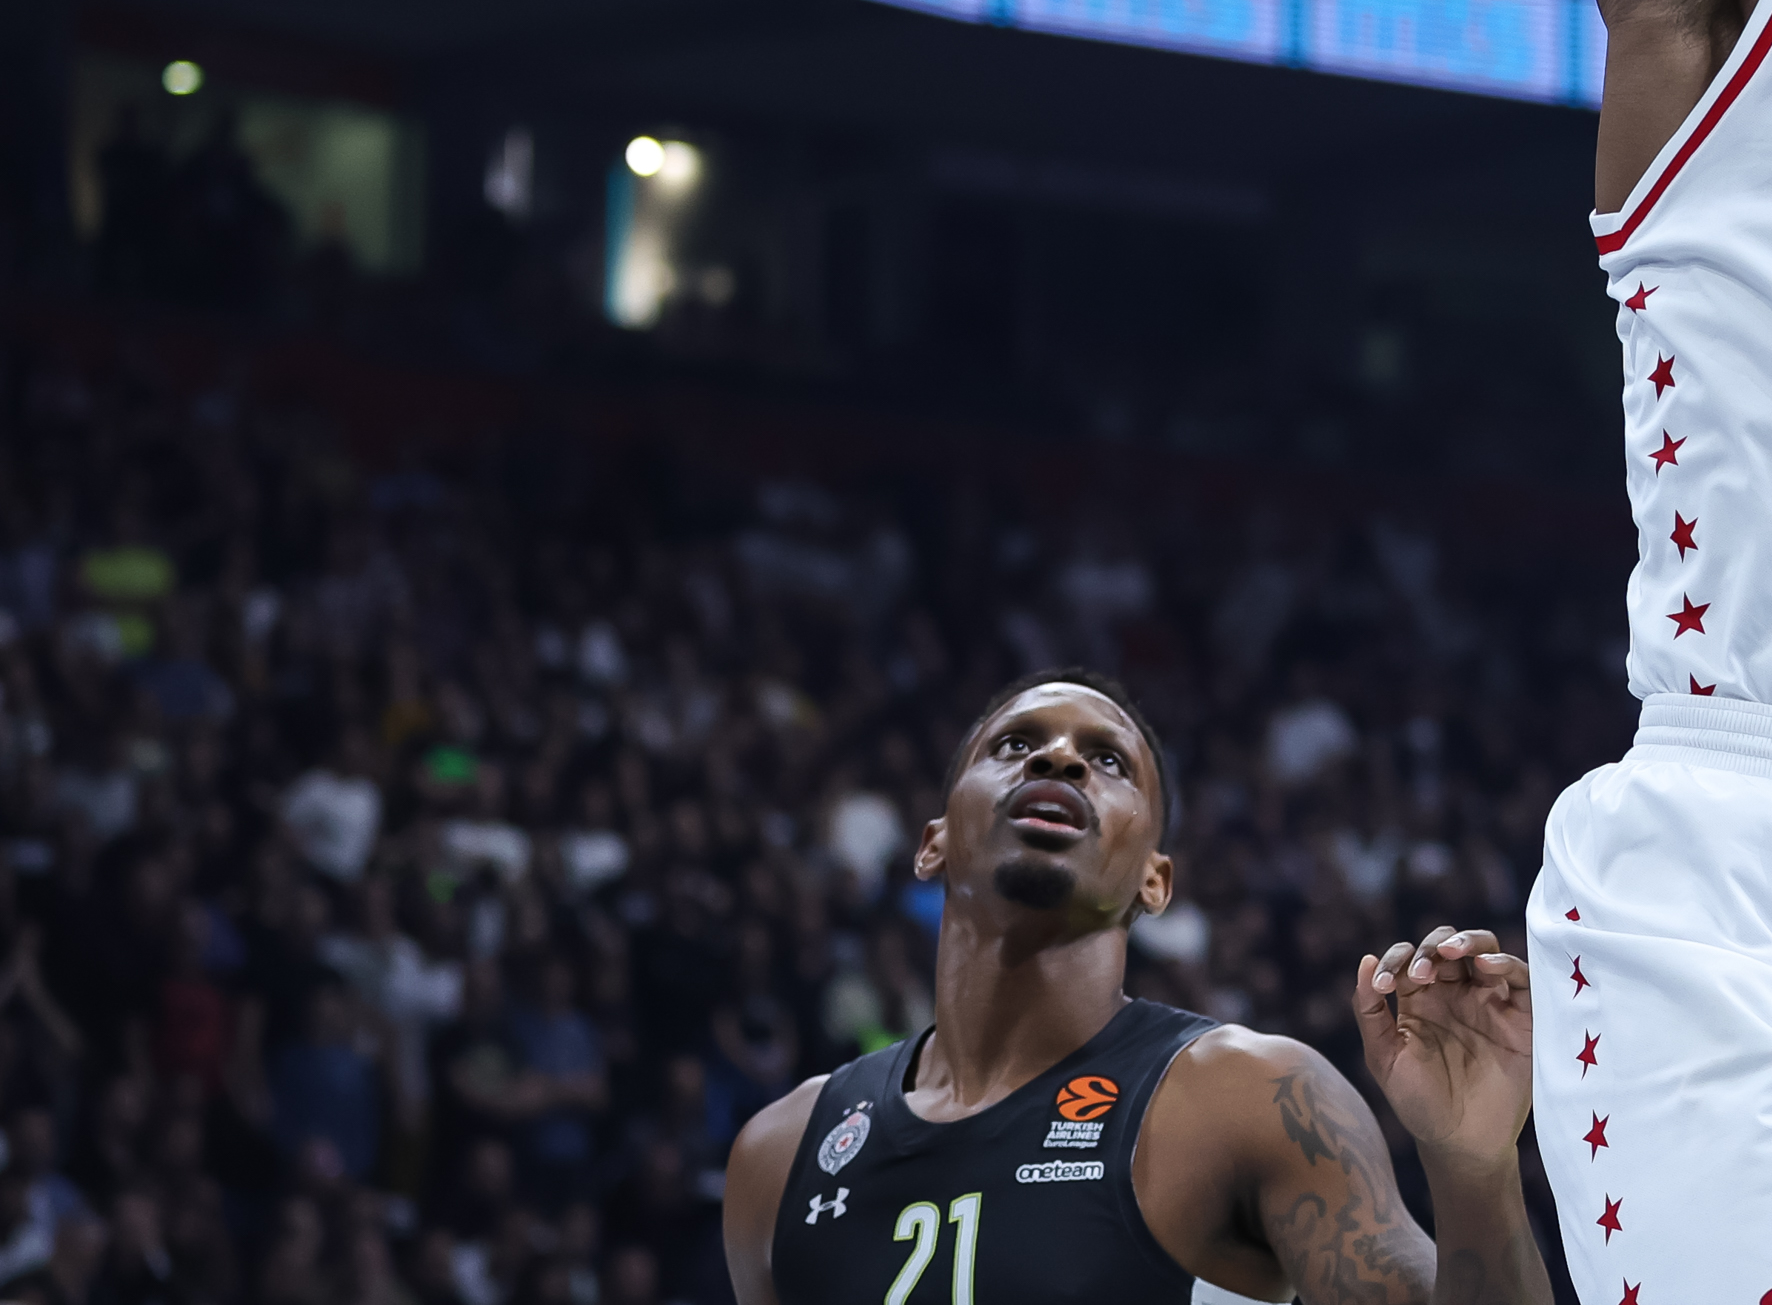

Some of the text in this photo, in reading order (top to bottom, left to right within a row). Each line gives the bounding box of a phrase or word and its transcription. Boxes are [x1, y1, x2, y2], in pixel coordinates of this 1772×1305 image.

[1050, 1121, 1104, 1131] TURKISH
[1046, 1130, 1101, 1140] AIRLINES
[1020, 1164, 1101, 1180] oneteam
[884, 1192, 982, 1305] 21
